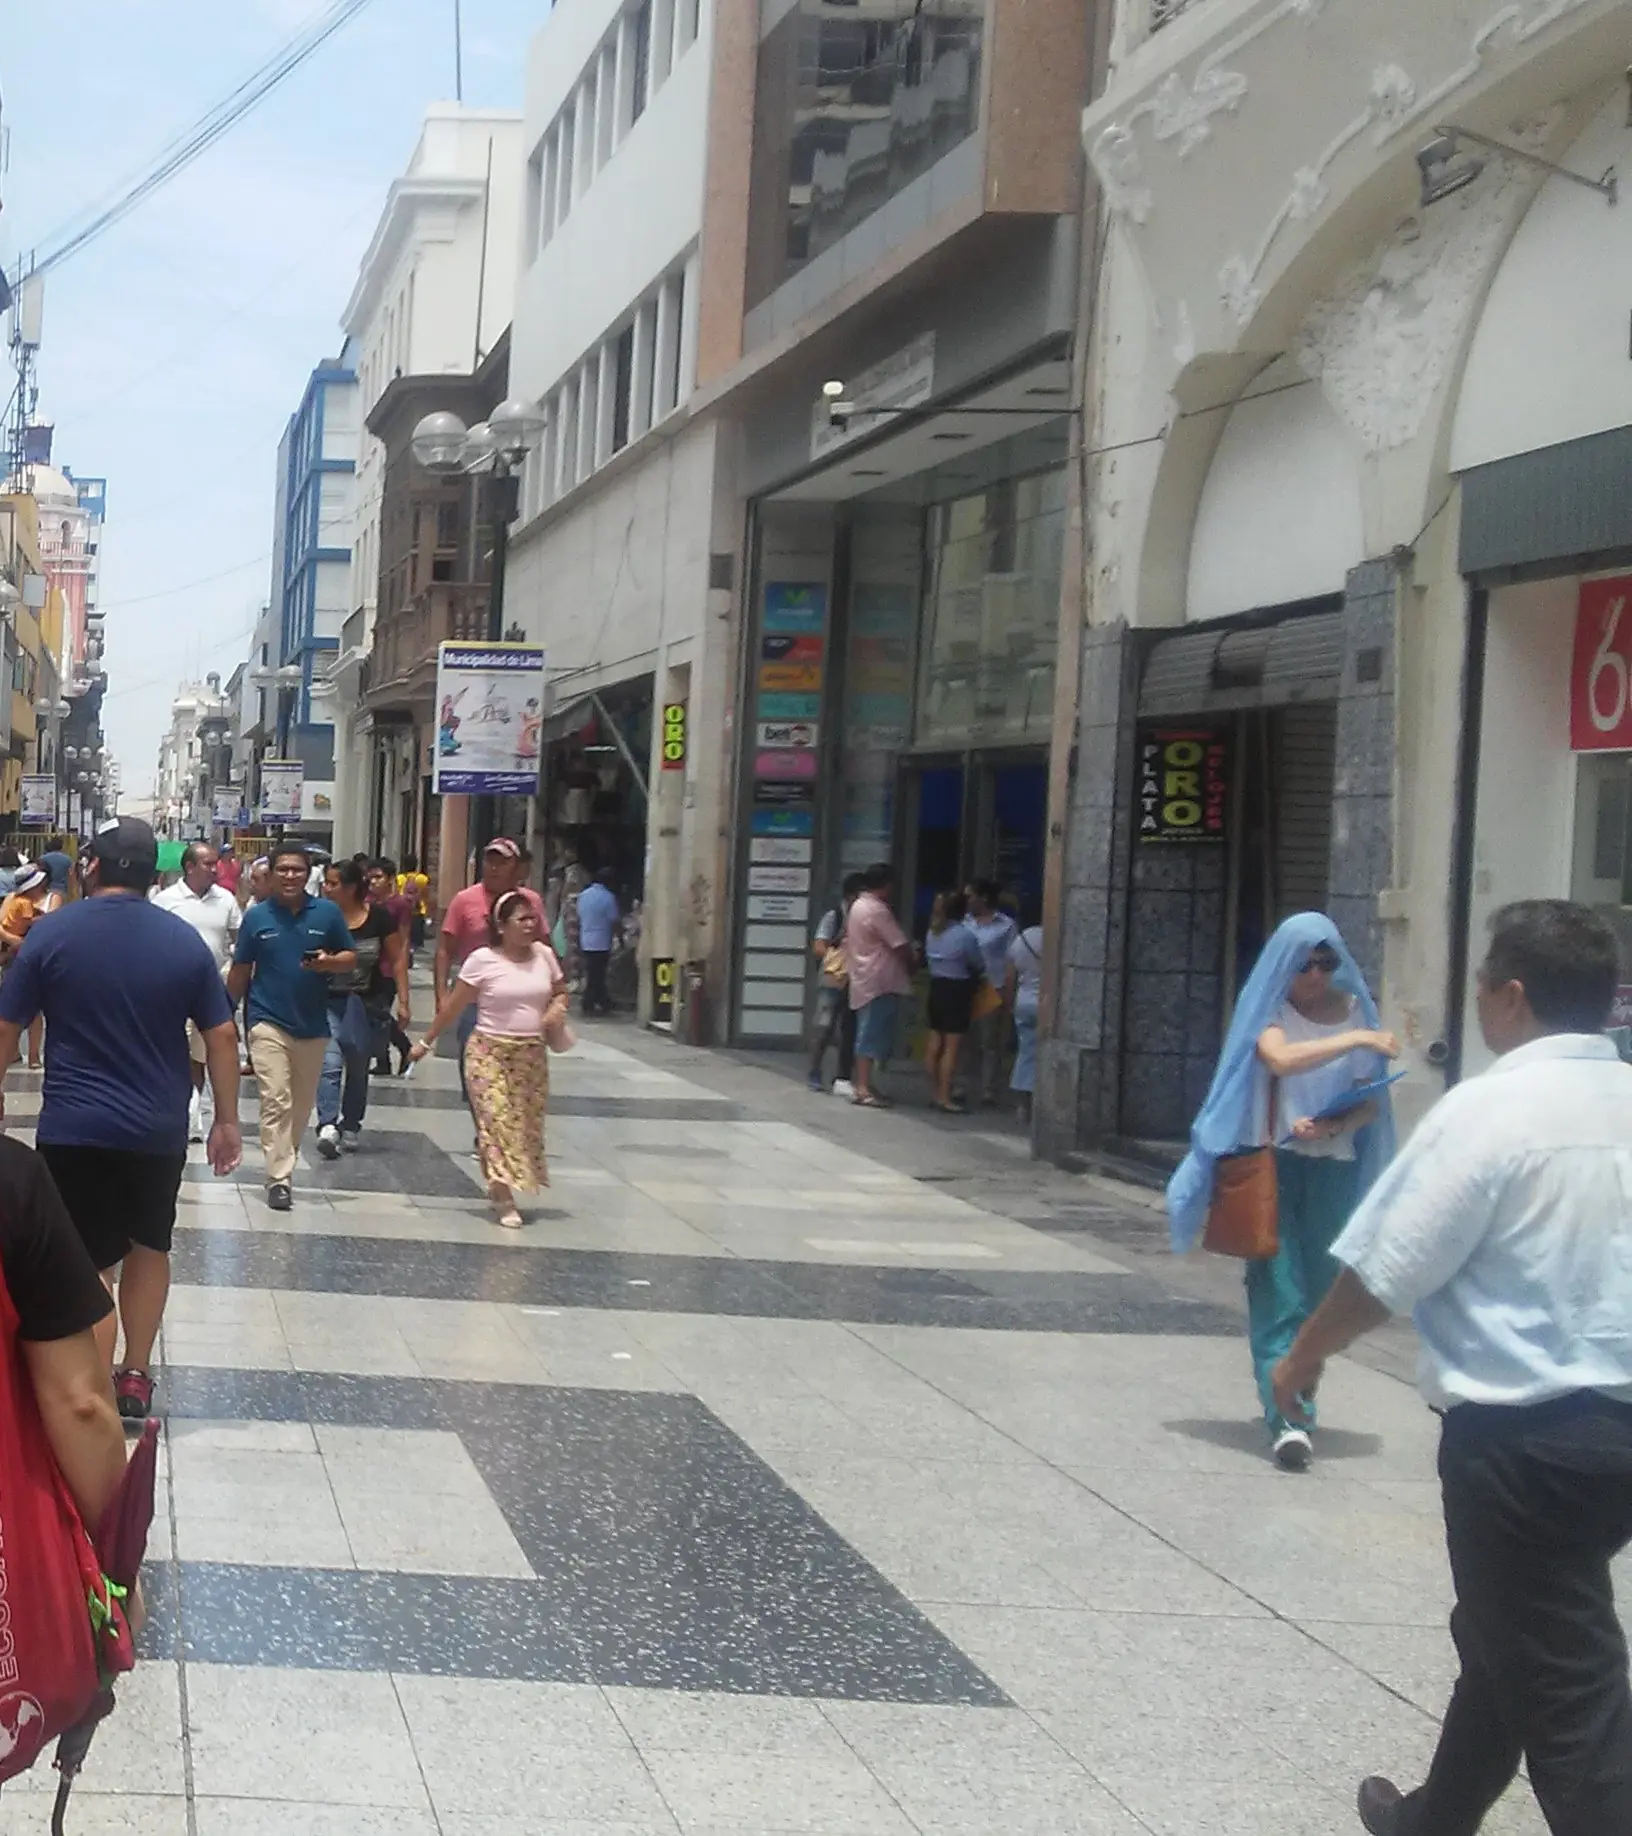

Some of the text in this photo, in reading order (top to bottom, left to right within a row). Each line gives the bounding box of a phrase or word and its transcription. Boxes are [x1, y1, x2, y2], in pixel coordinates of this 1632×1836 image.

[444, 653, 543, 668] Municipalidad de Lima
[1588, 594, 1632, 732] 6
[665, 704, 685, 760] ORO
[1140, 745, 1159, 830] PLATA
[1162, 741, 1204, 826] ORO
